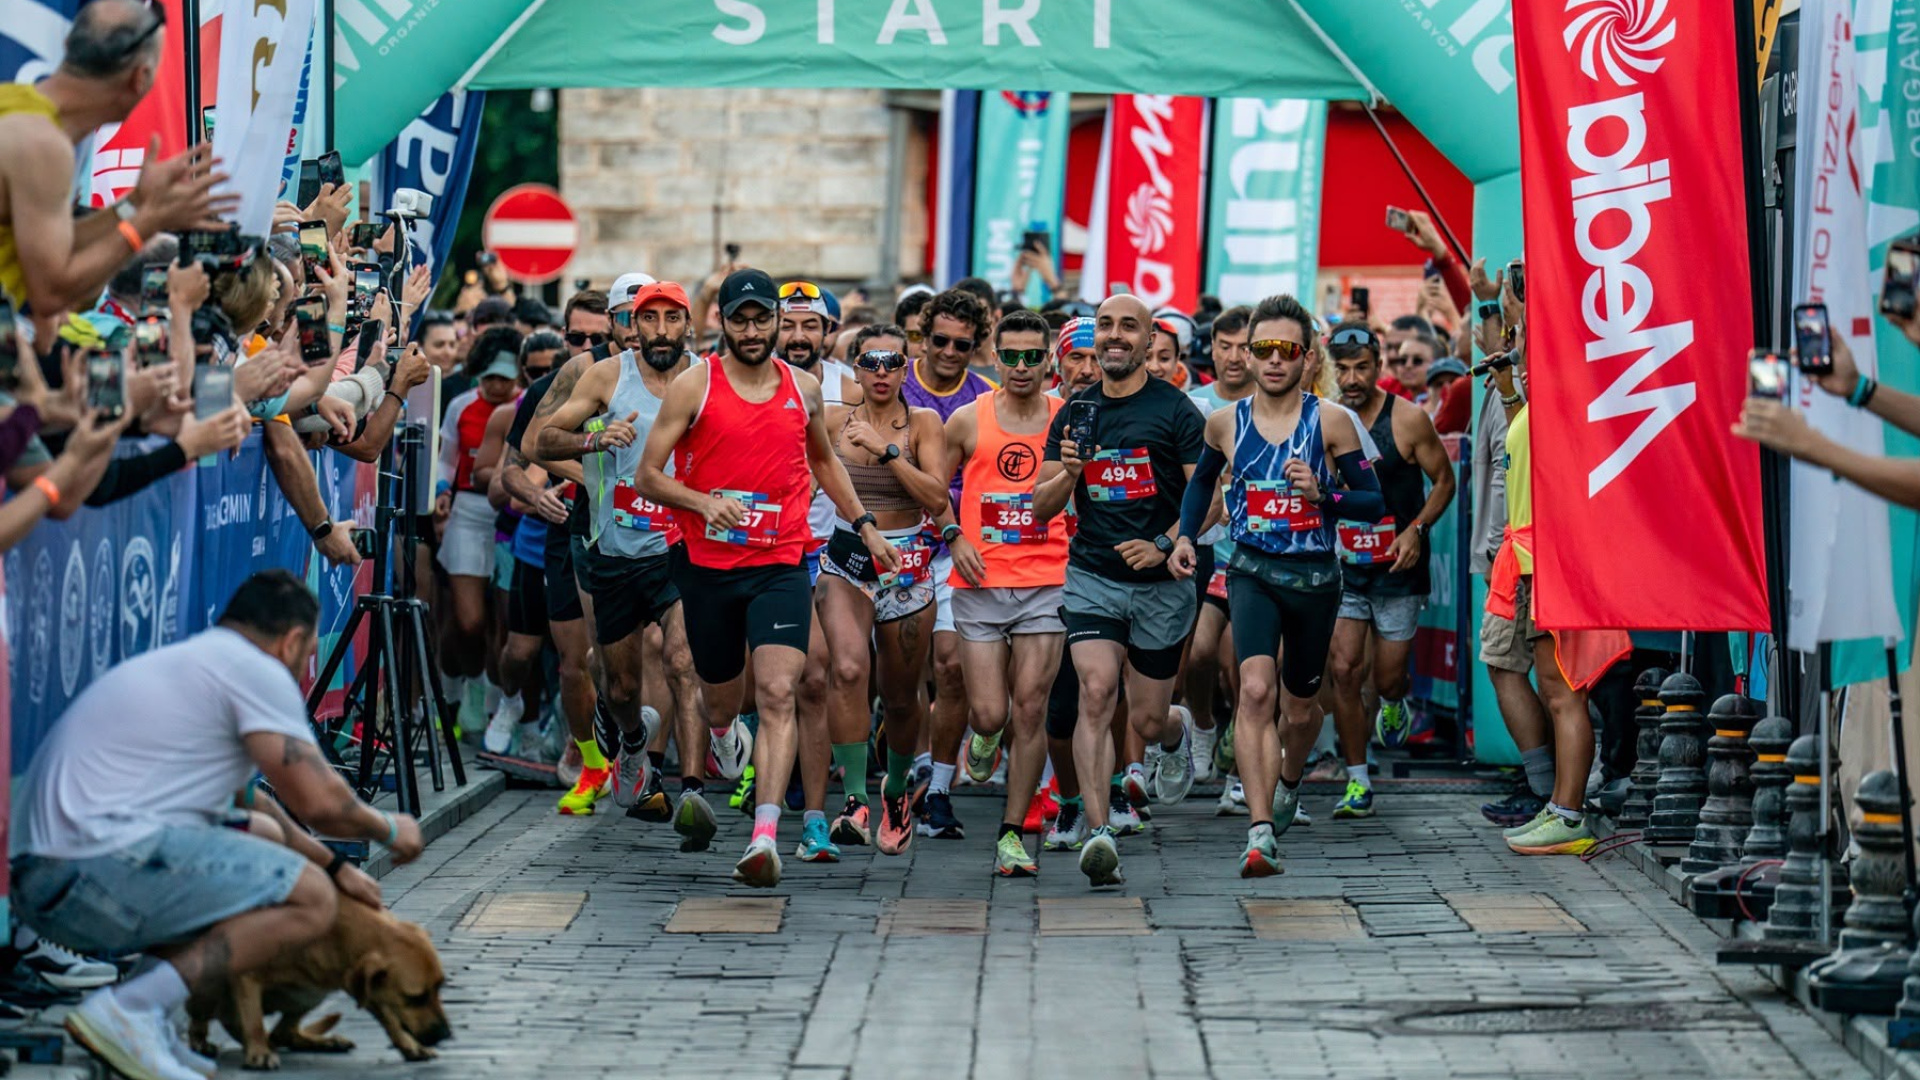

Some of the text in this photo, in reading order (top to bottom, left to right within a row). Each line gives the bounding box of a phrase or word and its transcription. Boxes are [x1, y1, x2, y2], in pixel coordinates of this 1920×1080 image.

[1101, 466, 1138, 482] 494
[1263, 497, 1303, 515] 475
[739, 511, 764, 528] 57
[997, 511, 1033, 526] 326
[1353, 534, 1380, 549] 231
[900, 552, 922, 569] 36
